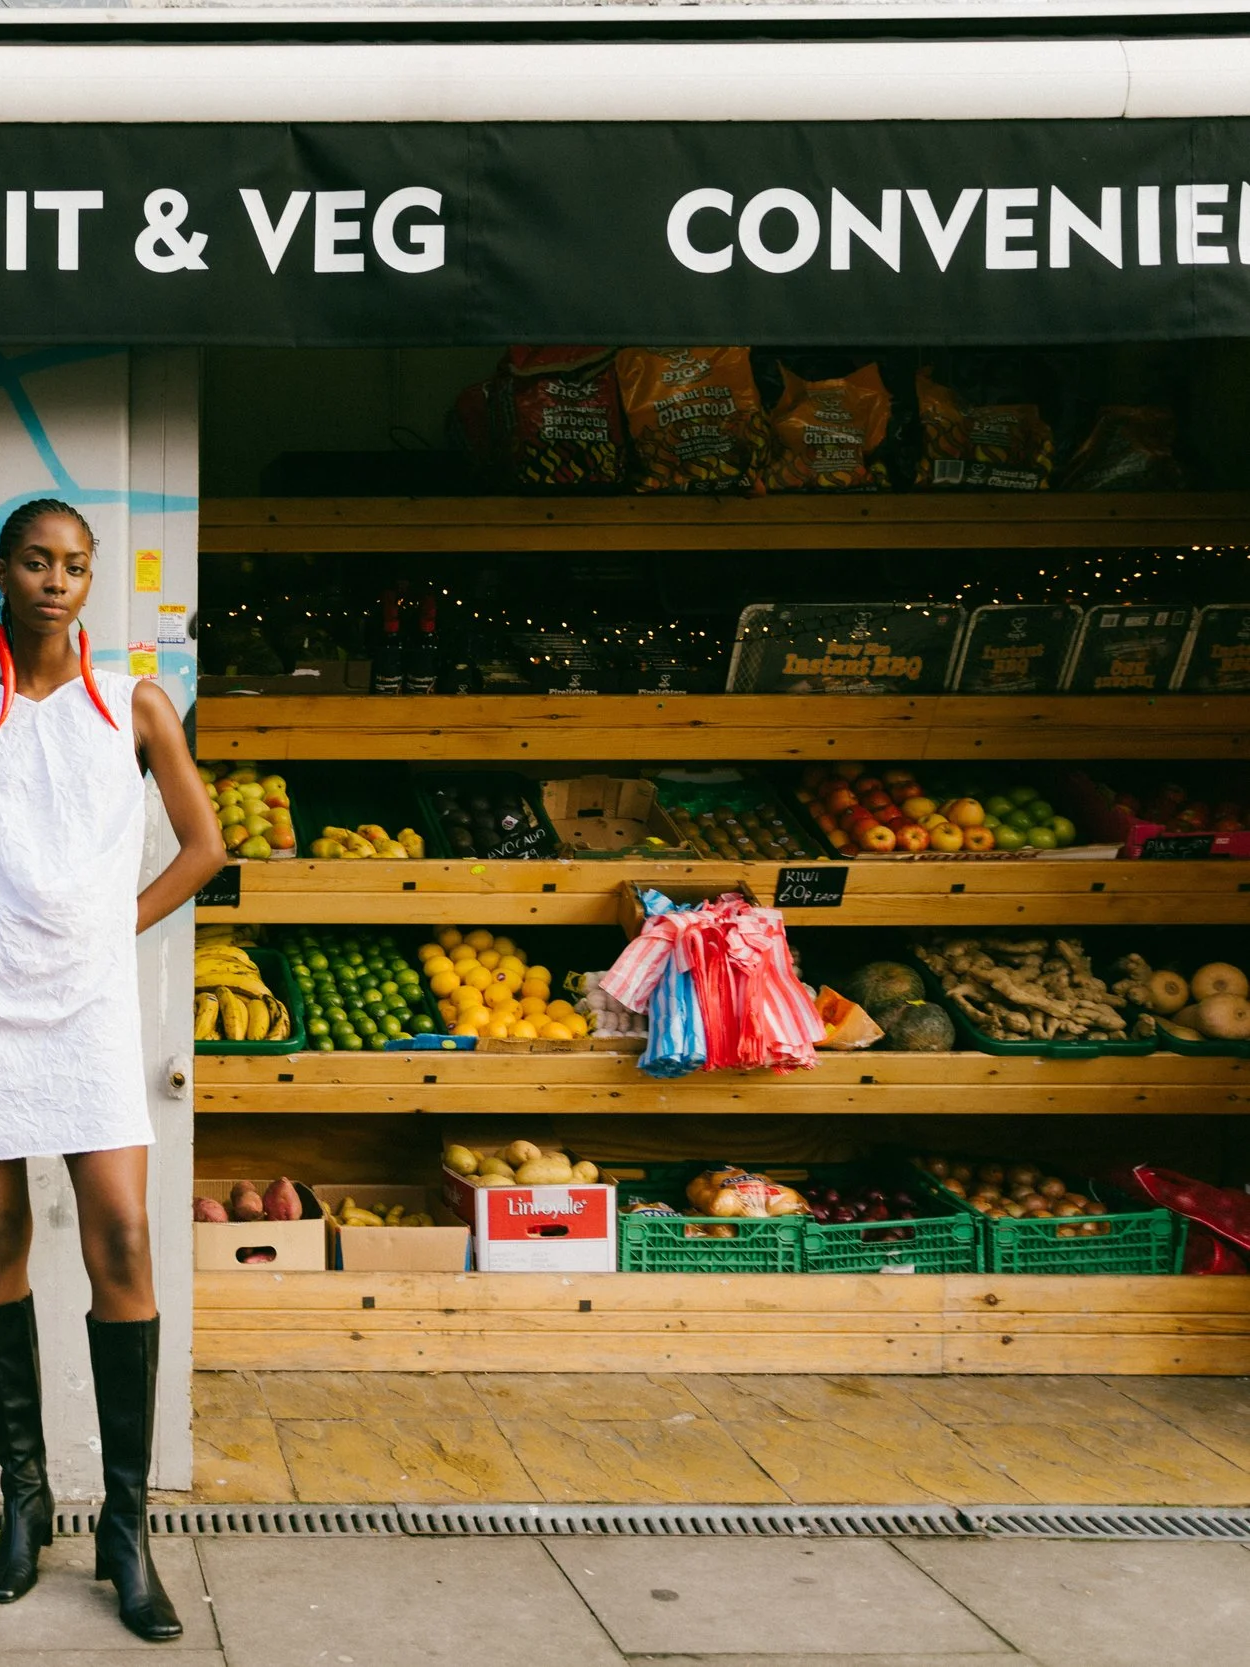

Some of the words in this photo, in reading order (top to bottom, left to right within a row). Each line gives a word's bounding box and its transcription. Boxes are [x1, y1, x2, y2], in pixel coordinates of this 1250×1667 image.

[135, 188, 209, 273] &
[239, 187, 444, 274] VEG
[667, 182, 1250, 273] CONVENIE
[658, 398, 737, 427] Charcoal
[542, 413, 609, 428] Barbecue
[542, 427, 610, 442] Charcoal
[803, 431, 864, 445] Charcoa
[826, 450, 856, 459] PACK
[1210, 644, 1250, 658] Insta
[783, 653, 870, 676] Instant
[871, 656, 922, 680] BBQ
[785, 871, 821, 883] KIWI
[778, 884, 813, 905] 60p
